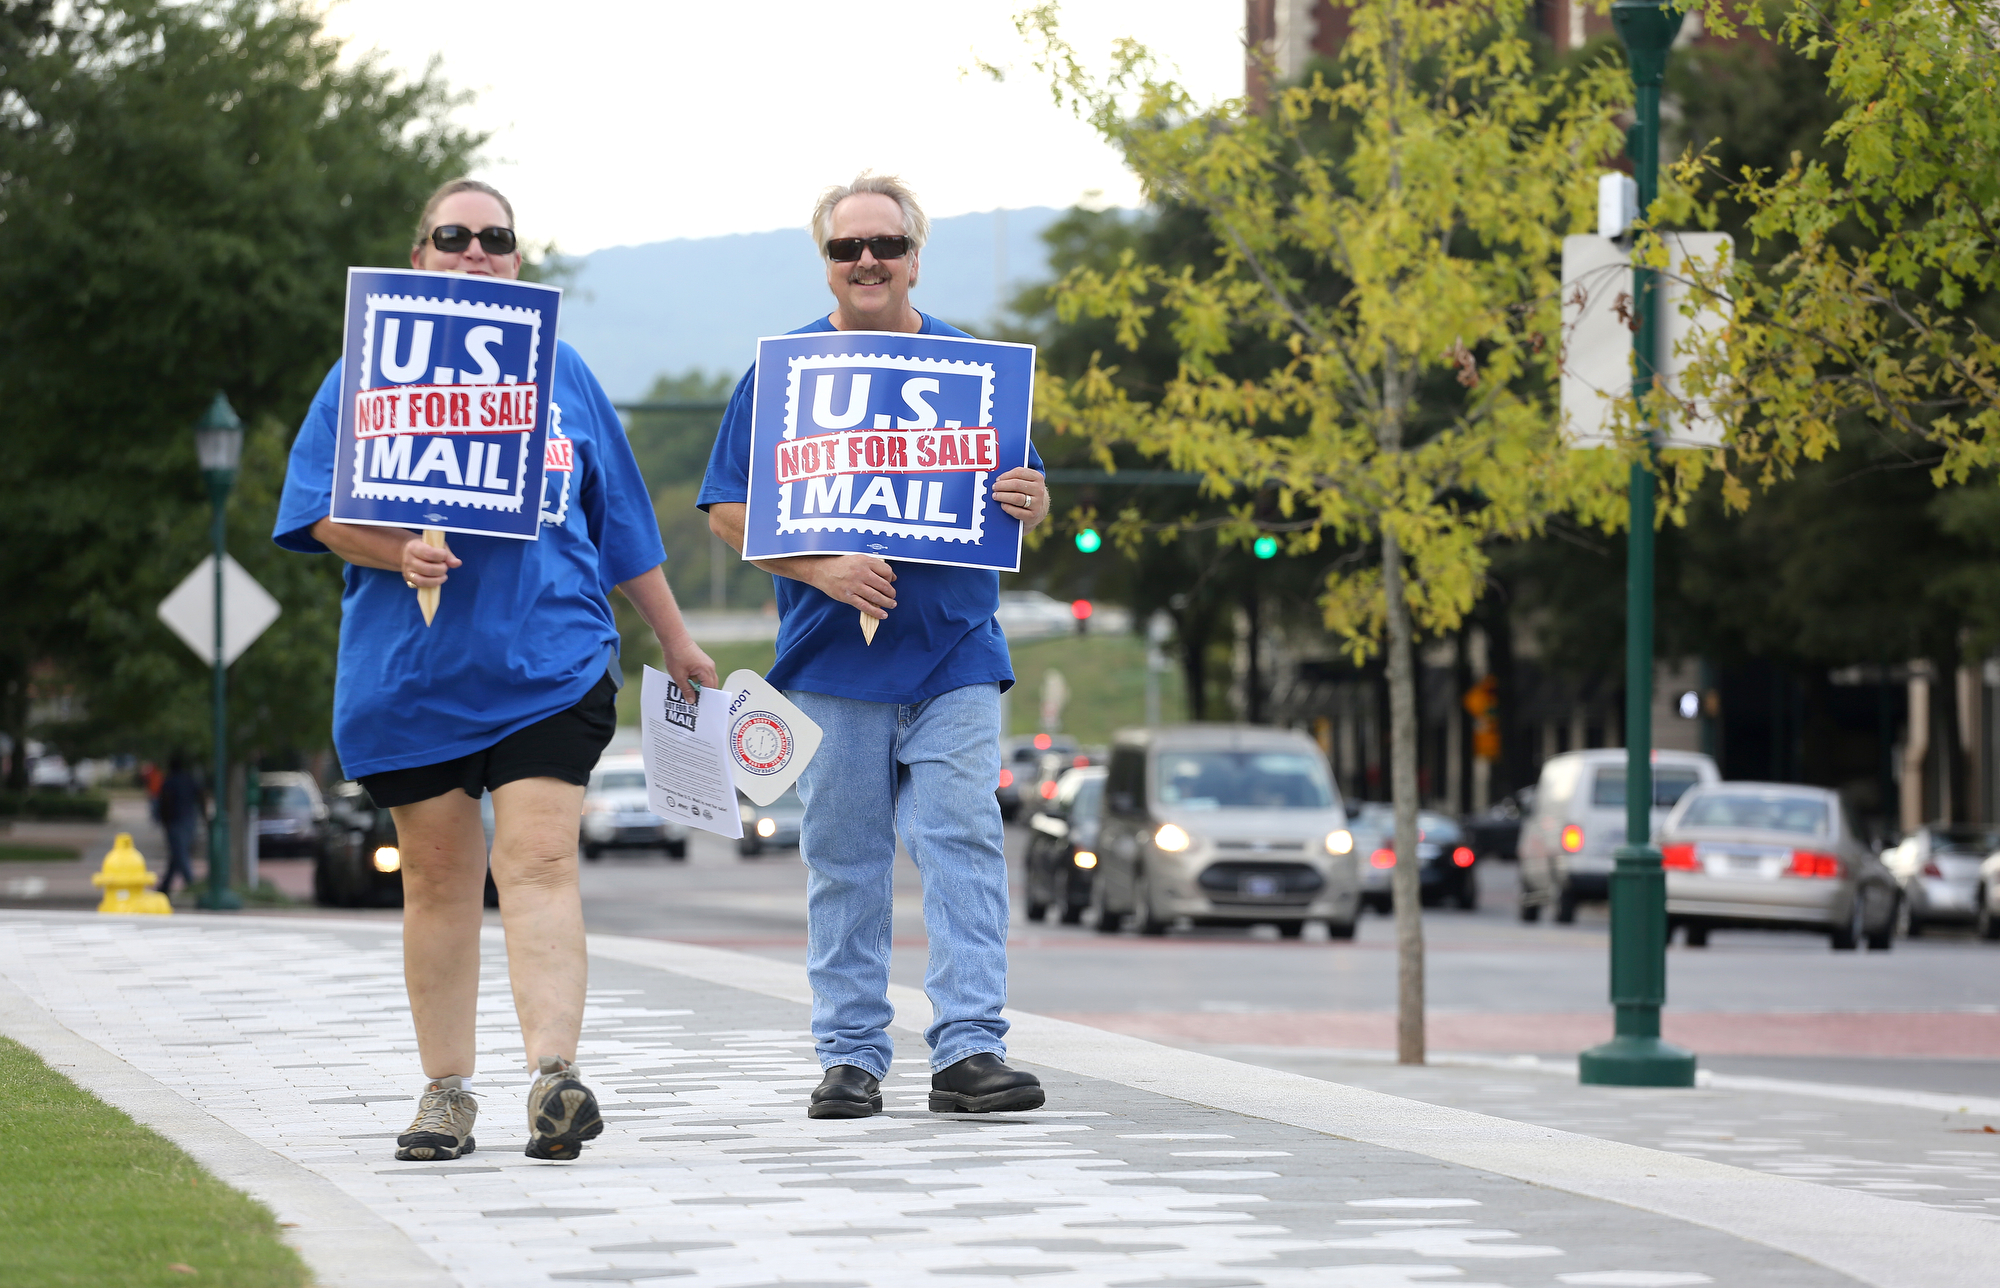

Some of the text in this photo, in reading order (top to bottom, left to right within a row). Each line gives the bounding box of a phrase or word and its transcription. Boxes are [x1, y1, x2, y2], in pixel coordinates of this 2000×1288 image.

[380, 318, 518, 385] U.S.
[359, 391, 534, 432] NOT FOR SALE
[811, 373, 962, 429] U.S.
[370, 435, 509, 490] MAIL
[545, 443, 570, 466] ALE
[781, 433, 993, 478] NOT FOR SALE
[802, 474, 958, 523] MAIL
[667, 710, 693, 728] MAIL
[780, 758, 786, 767] OF
